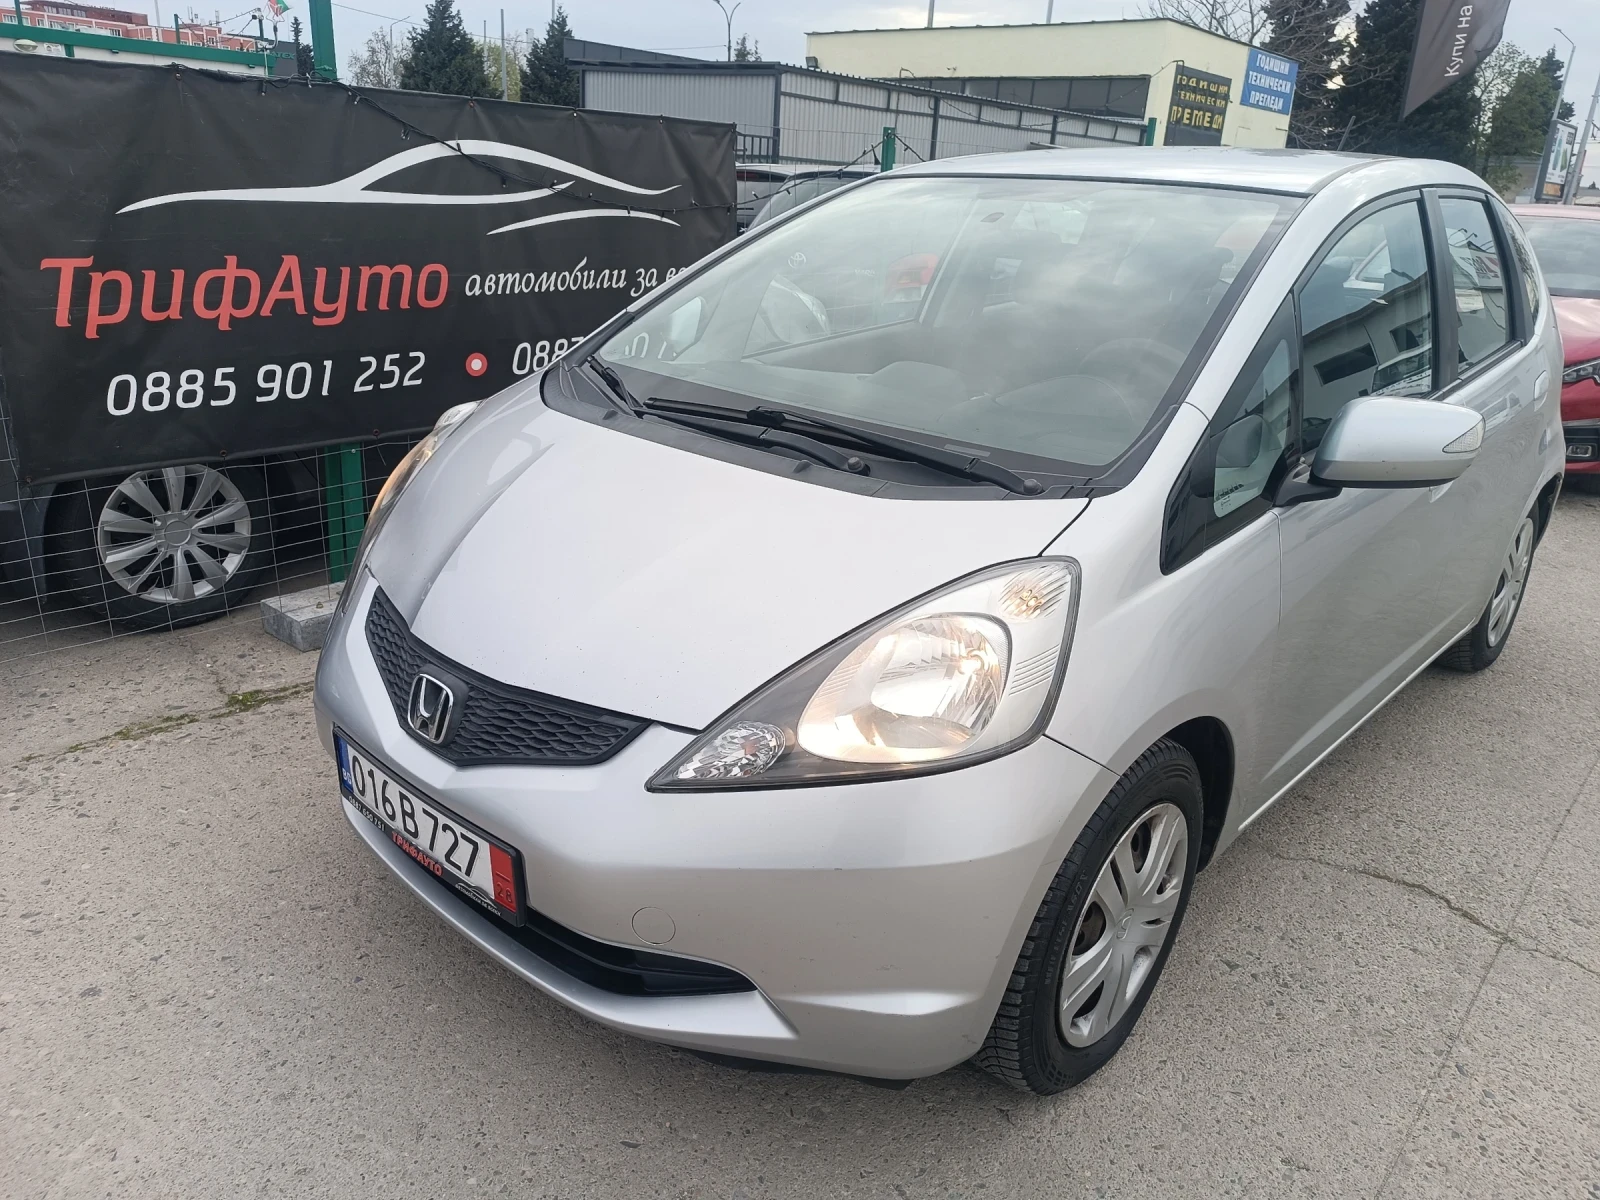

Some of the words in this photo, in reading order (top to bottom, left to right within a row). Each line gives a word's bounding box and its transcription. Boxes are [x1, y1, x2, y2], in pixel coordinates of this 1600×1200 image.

[1444, 33, 1467, 77] Купи
[1457, 5, 1473, 28] на
[1256, 53, 1290, 75] ГОДИШНИ
[1176, 74, 1229, 95] ГОДИШНИ
[1248, 70, 1291, 94] ТЕХНИЧЕСКИ
[1177, 90, 1226, 108] ЕХНИЧЕСКИ
[1249, 90, 1284, 111] ПРЕГЛЕДИ
[465, 256, 627, 296] автомобили
[629, 267, 658, 298] за
[40, 255, 449, 339] ТрифАуто
[106, 367, 236, 416] 0885
[255, 360, 333, 403] 901
[353, 351, 426, 393] 252
[391, 830, 443, 877] ТРИФАУТО
